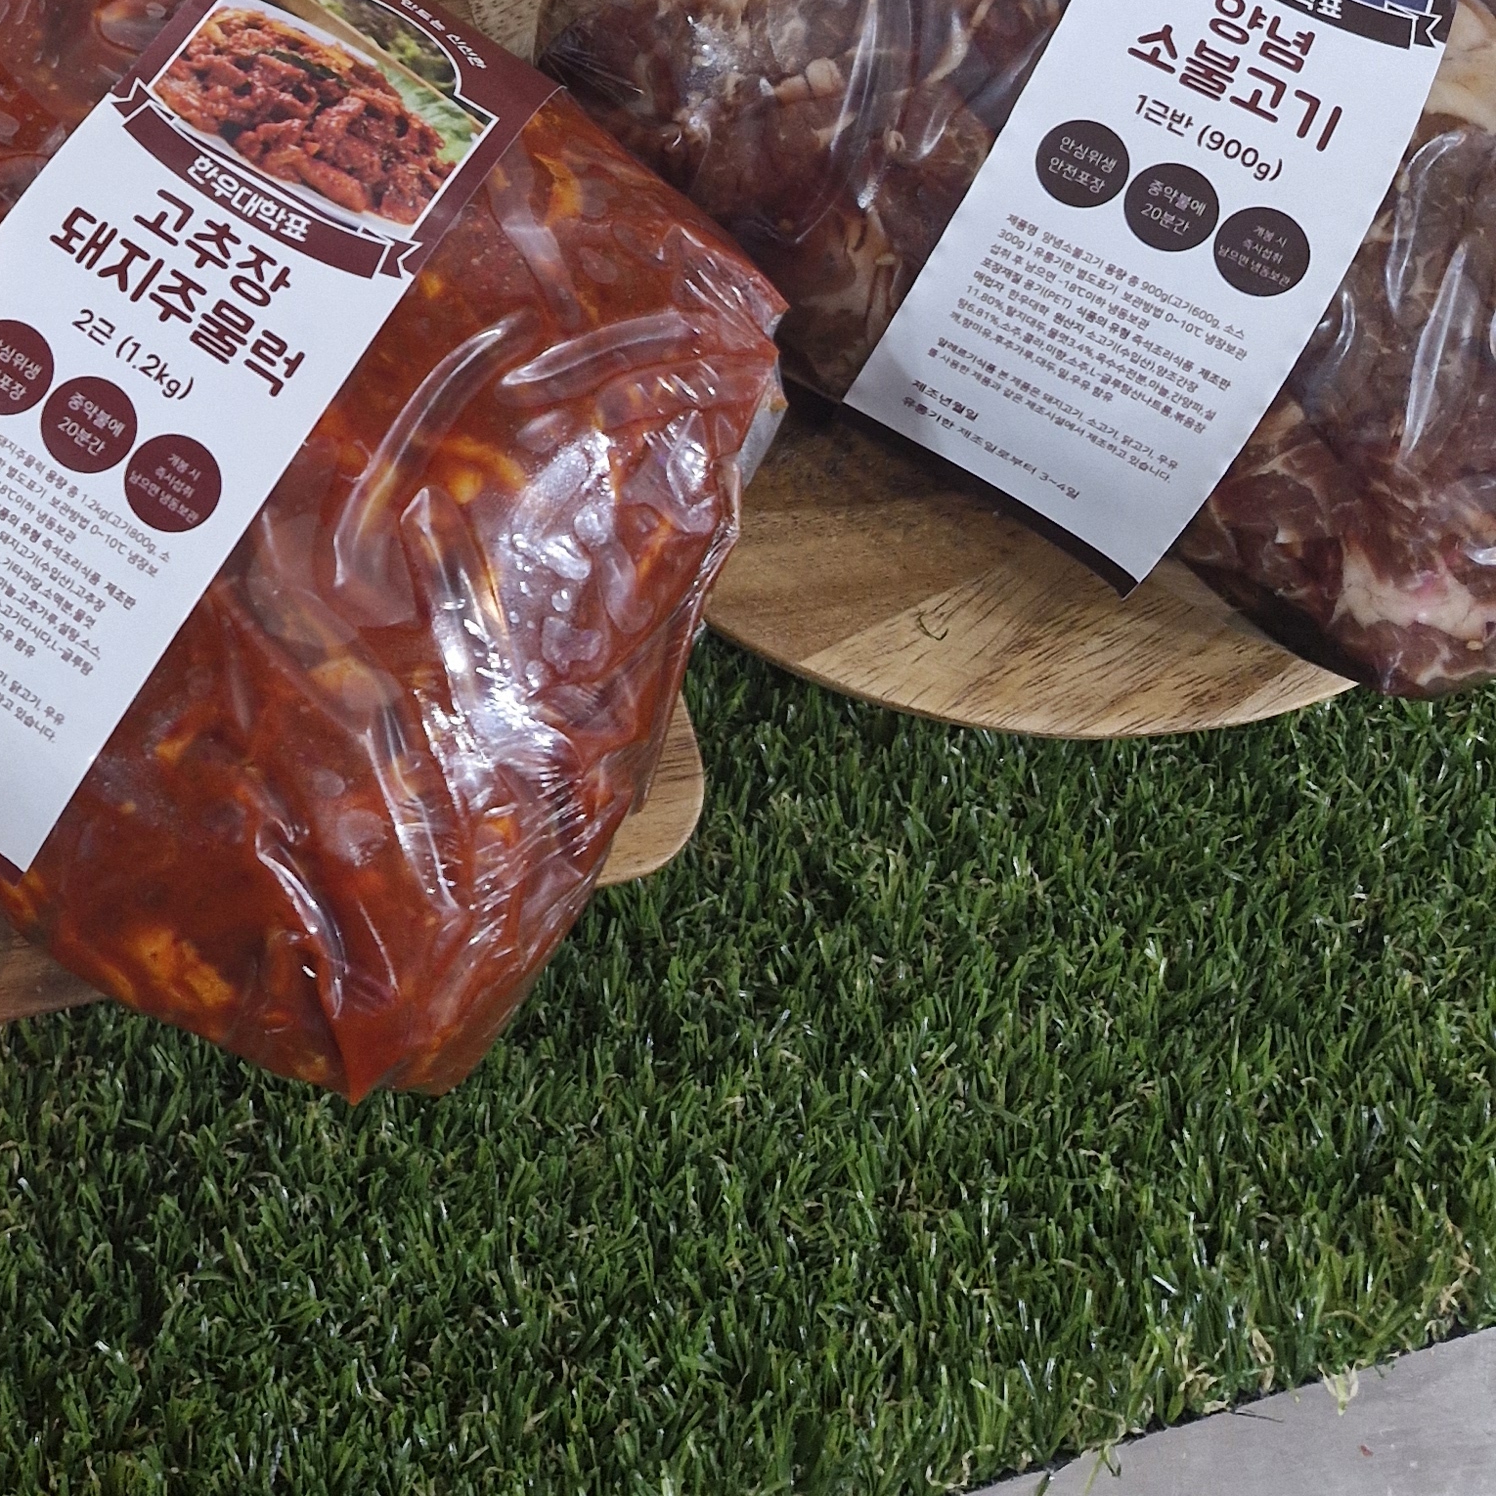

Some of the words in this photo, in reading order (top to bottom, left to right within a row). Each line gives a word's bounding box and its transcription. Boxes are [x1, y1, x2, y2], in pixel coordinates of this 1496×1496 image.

[446, 33, 488, 70] 신선한
[1128, 25, 1342, 151] 소불고기
[1060, 137, 1117, 173] 안심위생
[1136, 95, 1193, 137] 1근반
[1198, 125, 1282, 181] (900g)
[186, 153, 314, 241] 한우대학표
[1049, 157, 1105, 193] 안전포장
[1148, 180, 1206, 216] 중약불에
[1141, 203, 1189, 235] 20분간
[1254, 226, 1274, 242] 개봉
[133, 189, 290, 307] 고추장
[1218, 245, 1249, 267] 남으면
[1251, 260, 1290, 286] 냉동보관
[1244, 239, 1283, 264] 즉시섭취
[990, 244, 1012, 260] 섭취
[1025, 261, 1057, 283] 남으면
[1108, 303, 1150, 331] 냉동보관
[998, 229, 1025, 249] 300g
[1033, 247, 1075, 274] 유통기한
[1076, 268, 1118, 295] 별도표기
[1121, 291, 1164, 319] 보관방법
[1205, 333, 1247, 361] 냉장보관
[1007, 214, 1038, 236] 제품명
[1223, 325, 1244, 340] 소스
[50, 207, 305, 397] 돼지주물럭
[981, 258, 1023, 284] 포장재질
[1024, 279, 1072, 309] 용기(PET)
[1077, 307, 1108, 327] 식품의
[1109, 323, 1130, 339] 유형
[1132, 334, 1194, 372] 즉석조리식품
[1198, 368, 1230, 391] 제조판
[72, 309, 115, 345] 2근
[116, 336, 193, 400] (1.2kg)
[68, 392, 125, 437] 중약불에
[909, 380, 978, 421] 제조년월일
[58, 417, 105, 456] 20분간
[900, 393, 954, 429] 유통기한
[957, 427, 1037, 474] 제조일로부터
[1039, 472, 1080, 499] 3~4일
[155, 466, 194, 498] 즉시섭취
[168, 454, 189, 473] 개봉
[6, 466, 47, 498] 별도표기
[49, 496, 90, 530] 보관방법
[127, 550, 158, 577] 냉장보
[129, 471, 161, 497] 남으면
[159, 491, 199, 524] 냉동보관
[36, 510, 76, 544] 냉동보관
[20, 523, 42, 543] 유형
[42, 538, 101, 586] 즉석조리식품
